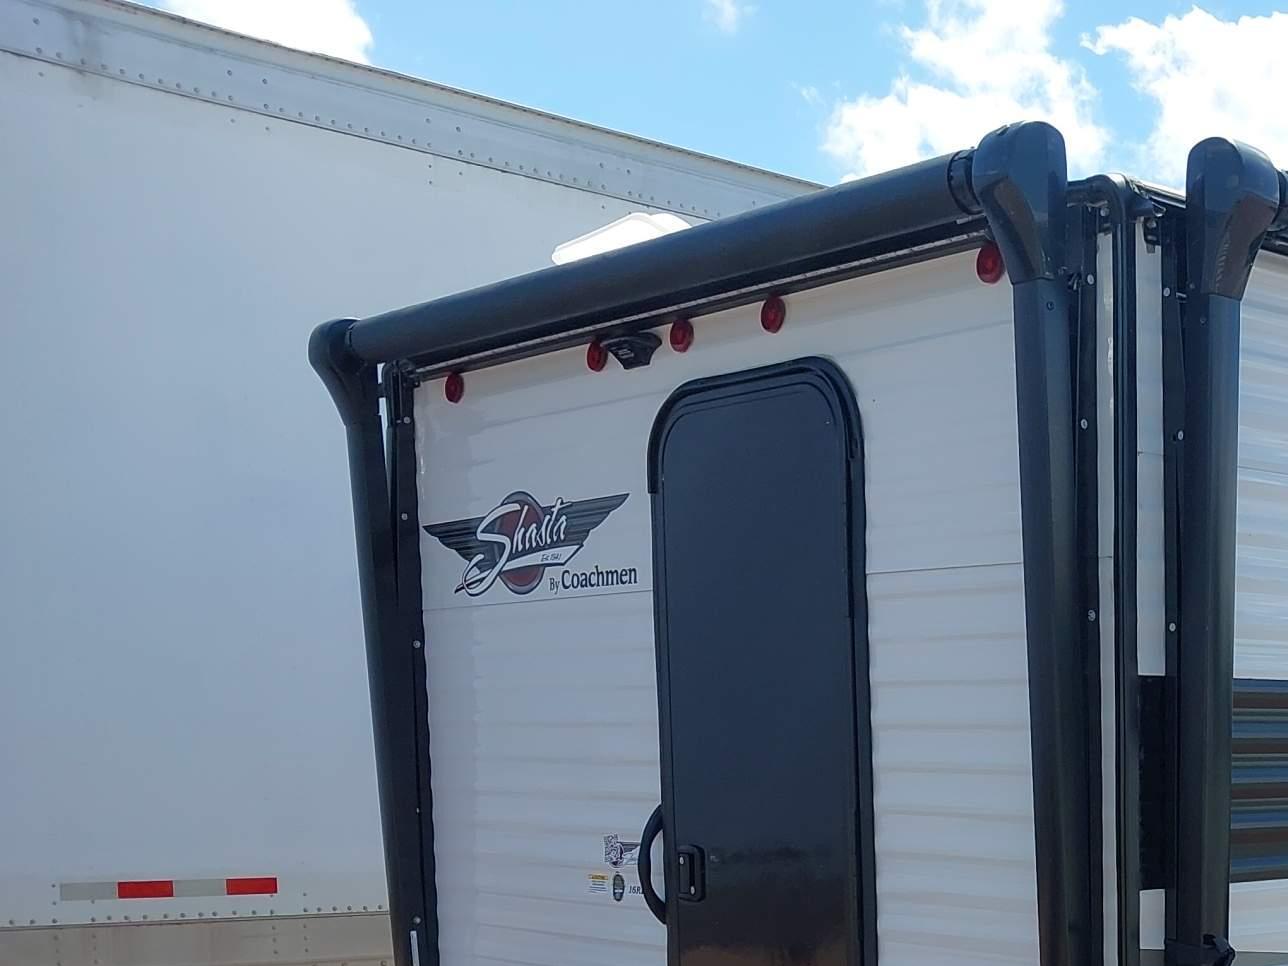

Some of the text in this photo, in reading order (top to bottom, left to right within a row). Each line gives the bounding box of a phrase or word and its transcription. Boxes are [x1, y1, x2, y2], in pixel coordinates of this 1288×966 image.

[463, 497, 573, 596] Shasta
[549, 565, 638, 594] By Coachmen
